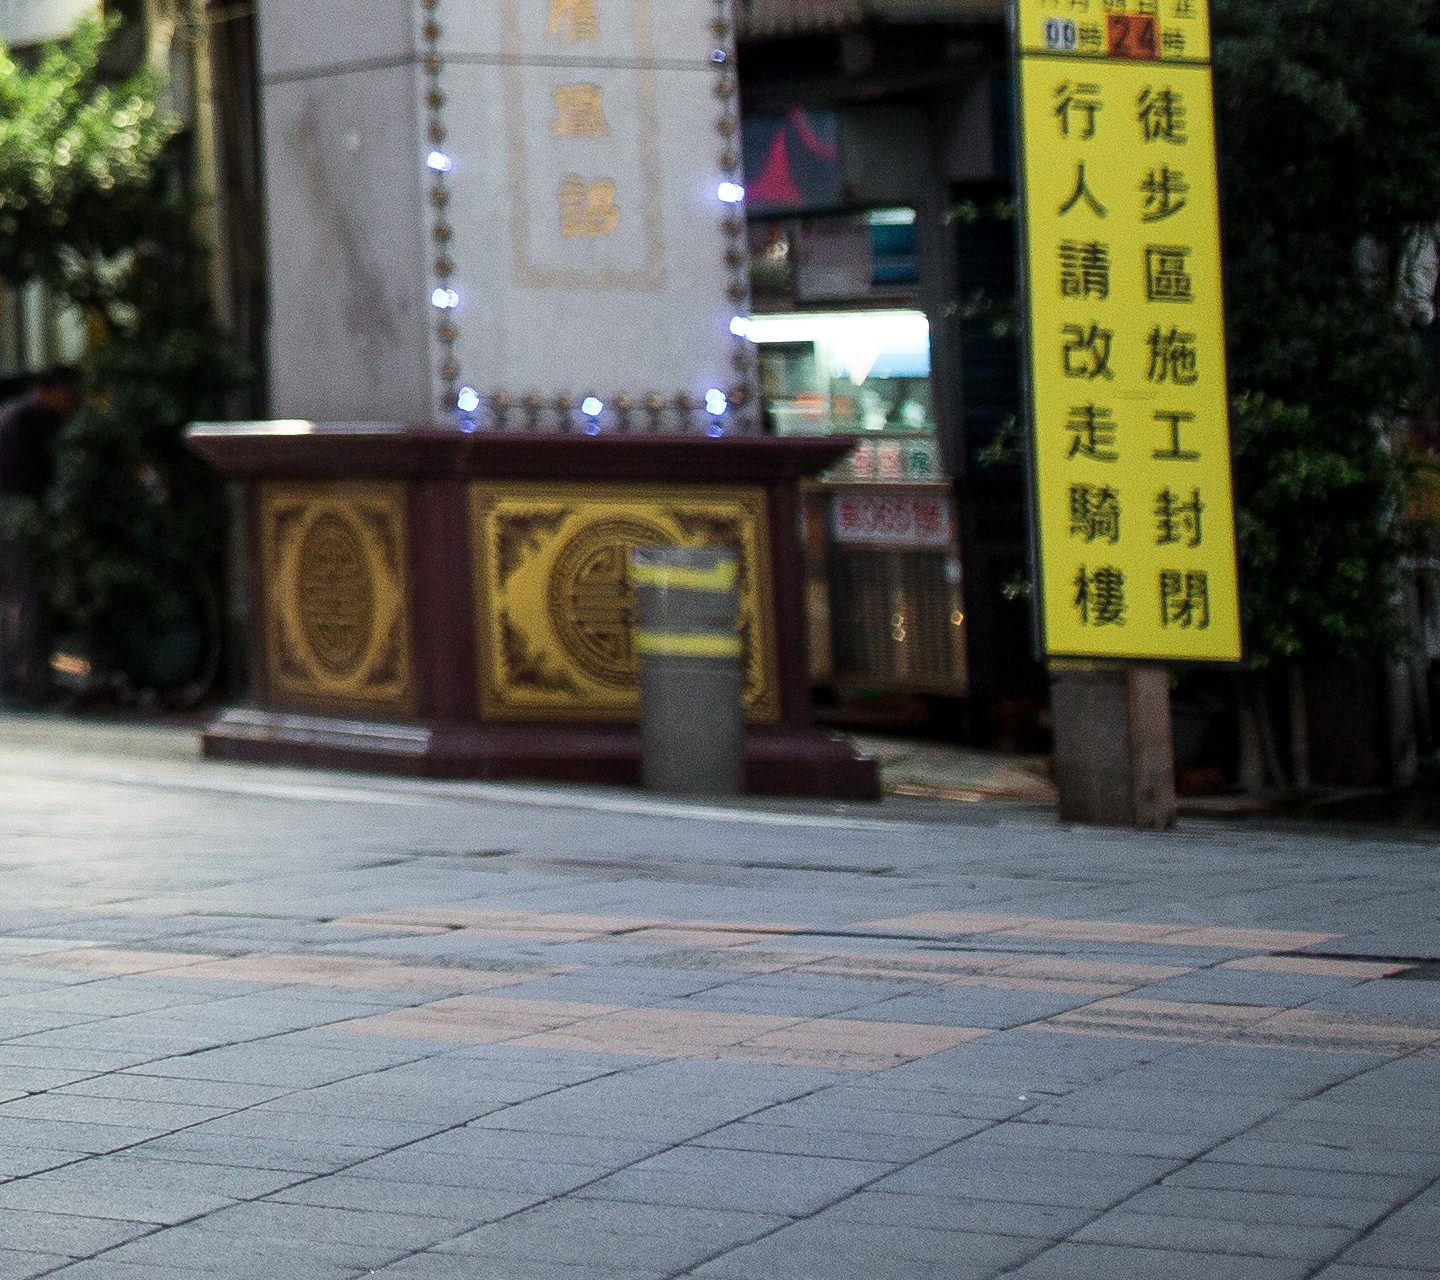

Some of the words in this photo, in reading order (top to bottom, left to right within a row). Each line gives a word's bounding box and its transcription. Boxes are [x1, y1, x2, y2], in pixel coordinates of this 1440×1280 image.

[1052, 80, 1128, 629] 行人請改走騎樓
[1135, 85, 1212, 632] 徒步區施工封閉
